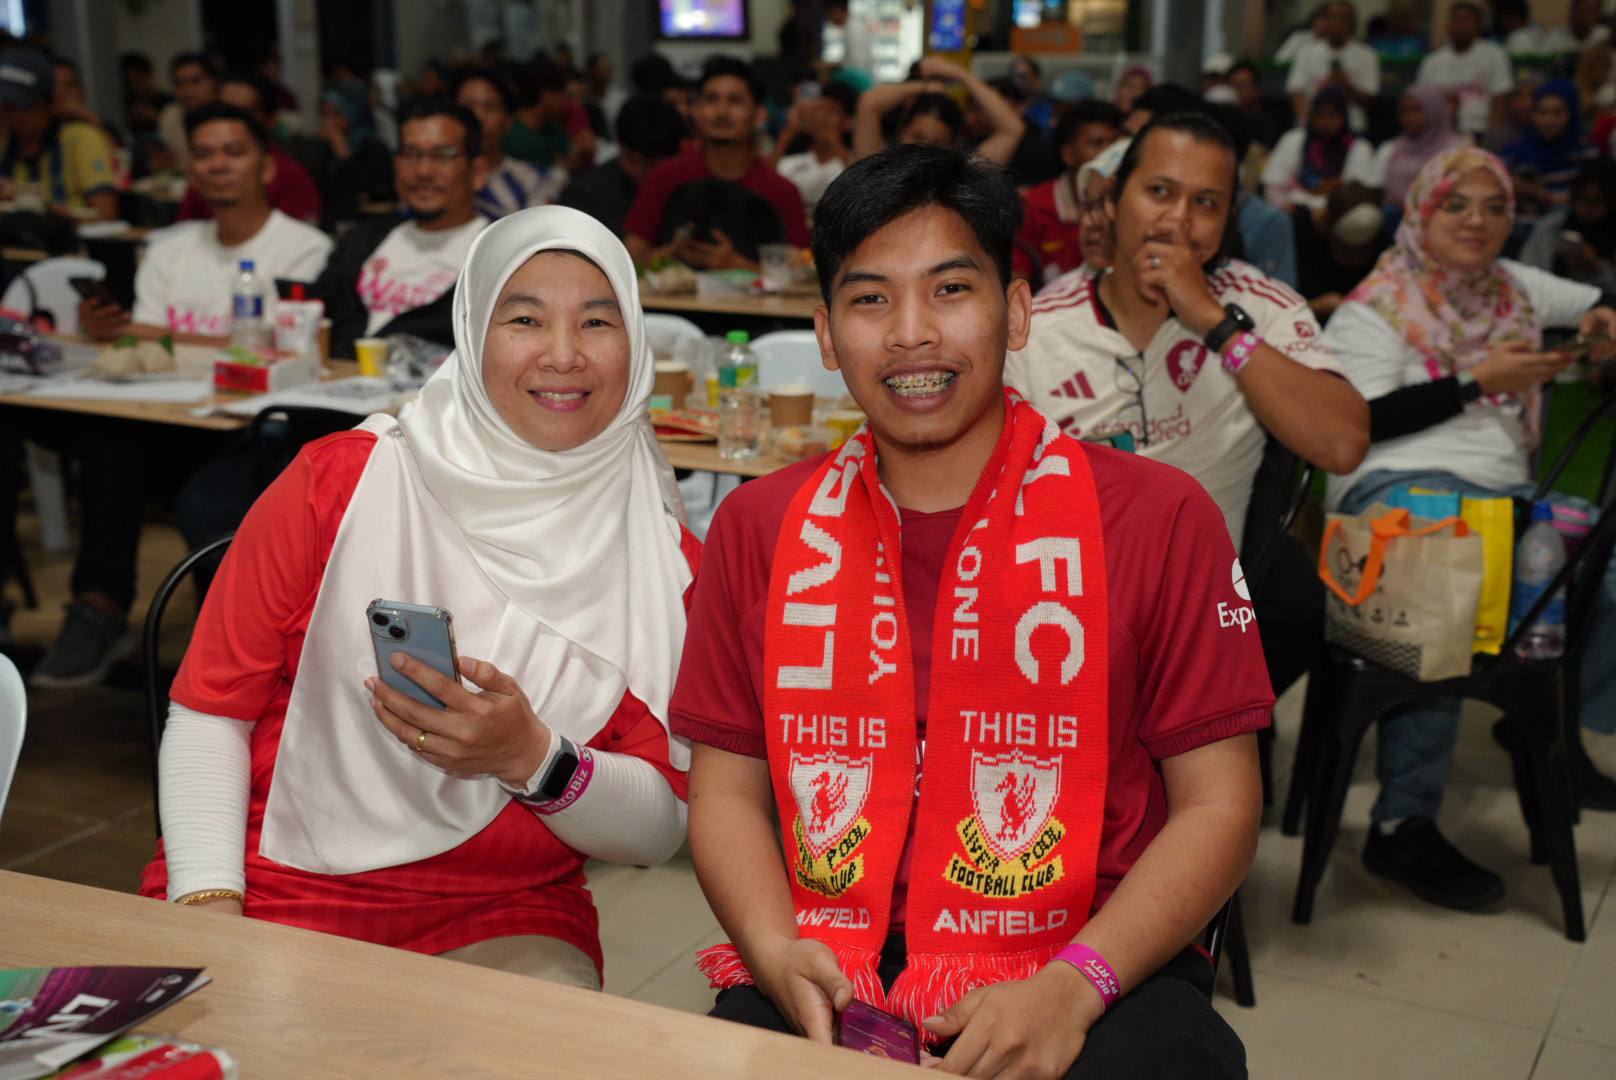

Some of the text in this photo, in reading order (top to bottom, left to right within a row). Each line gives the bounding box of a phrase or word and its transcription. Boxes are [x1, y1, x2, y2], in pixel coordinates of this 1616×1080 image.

[1217, 601, 1256, 633] Exp
[779, 713, 886, 748] THIS IS
[960, 711, 1077, 748] THIS IS
[951, 858, 1055, 896] FOOTBALL CLUB
[796, 907, 870, 929] ANFIELD
[933, 908, 1067, 935] ANFIELD
